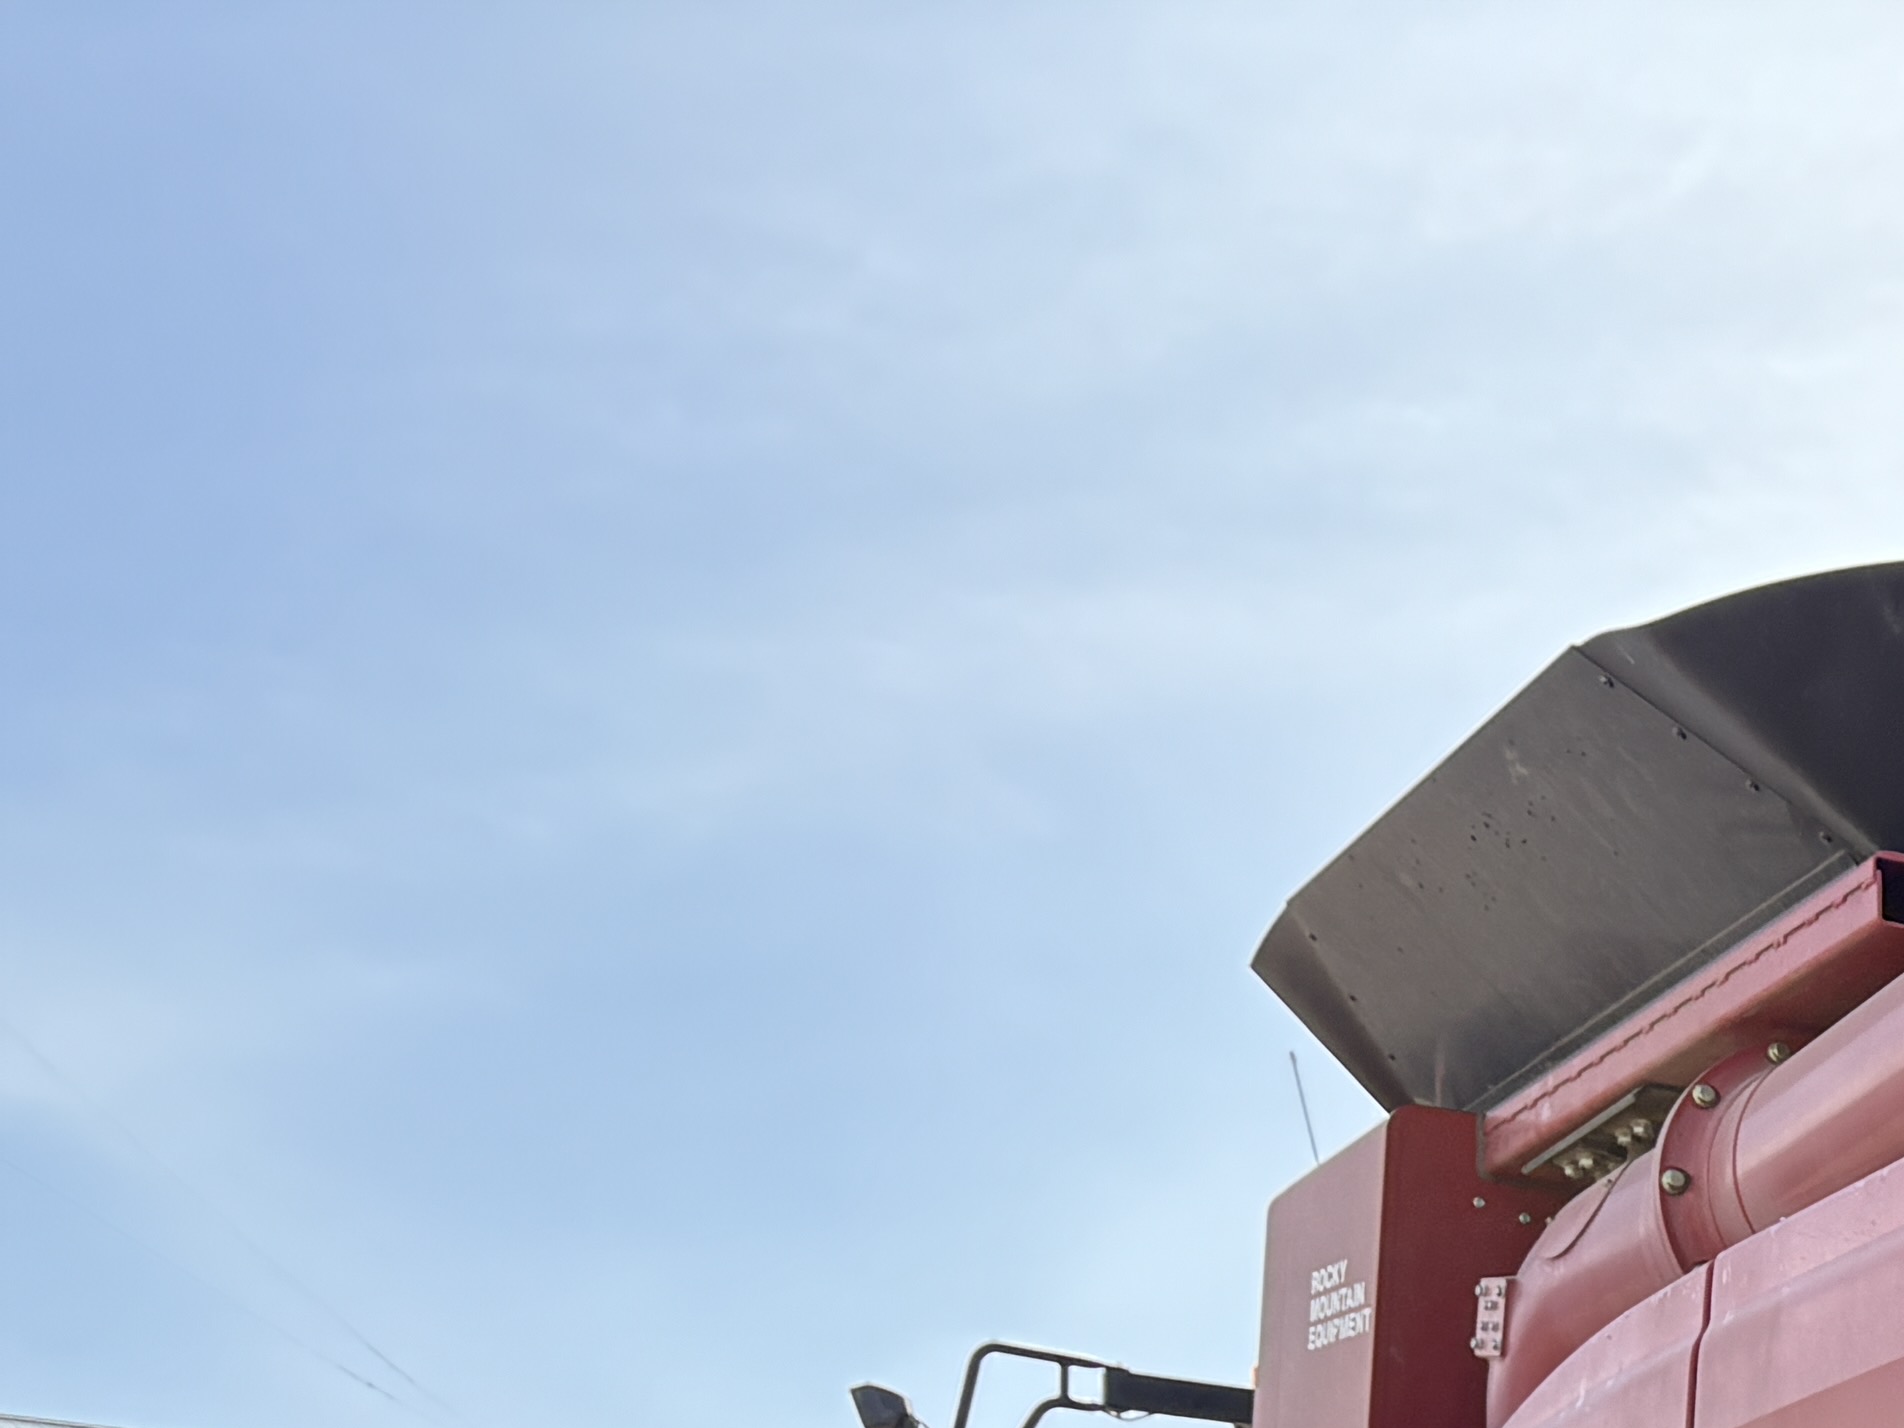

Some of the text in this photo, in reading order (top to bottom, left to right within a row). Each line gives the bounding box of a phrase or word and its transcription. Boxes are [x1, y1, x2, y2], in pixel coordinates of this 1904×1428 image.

[1311, 1259, 1348, 1295] ROCKY
[1310, 1281, 1366, 1322] MOUNTAIN
[1307, 1307, 1372, 1350] EQUIPMENT
